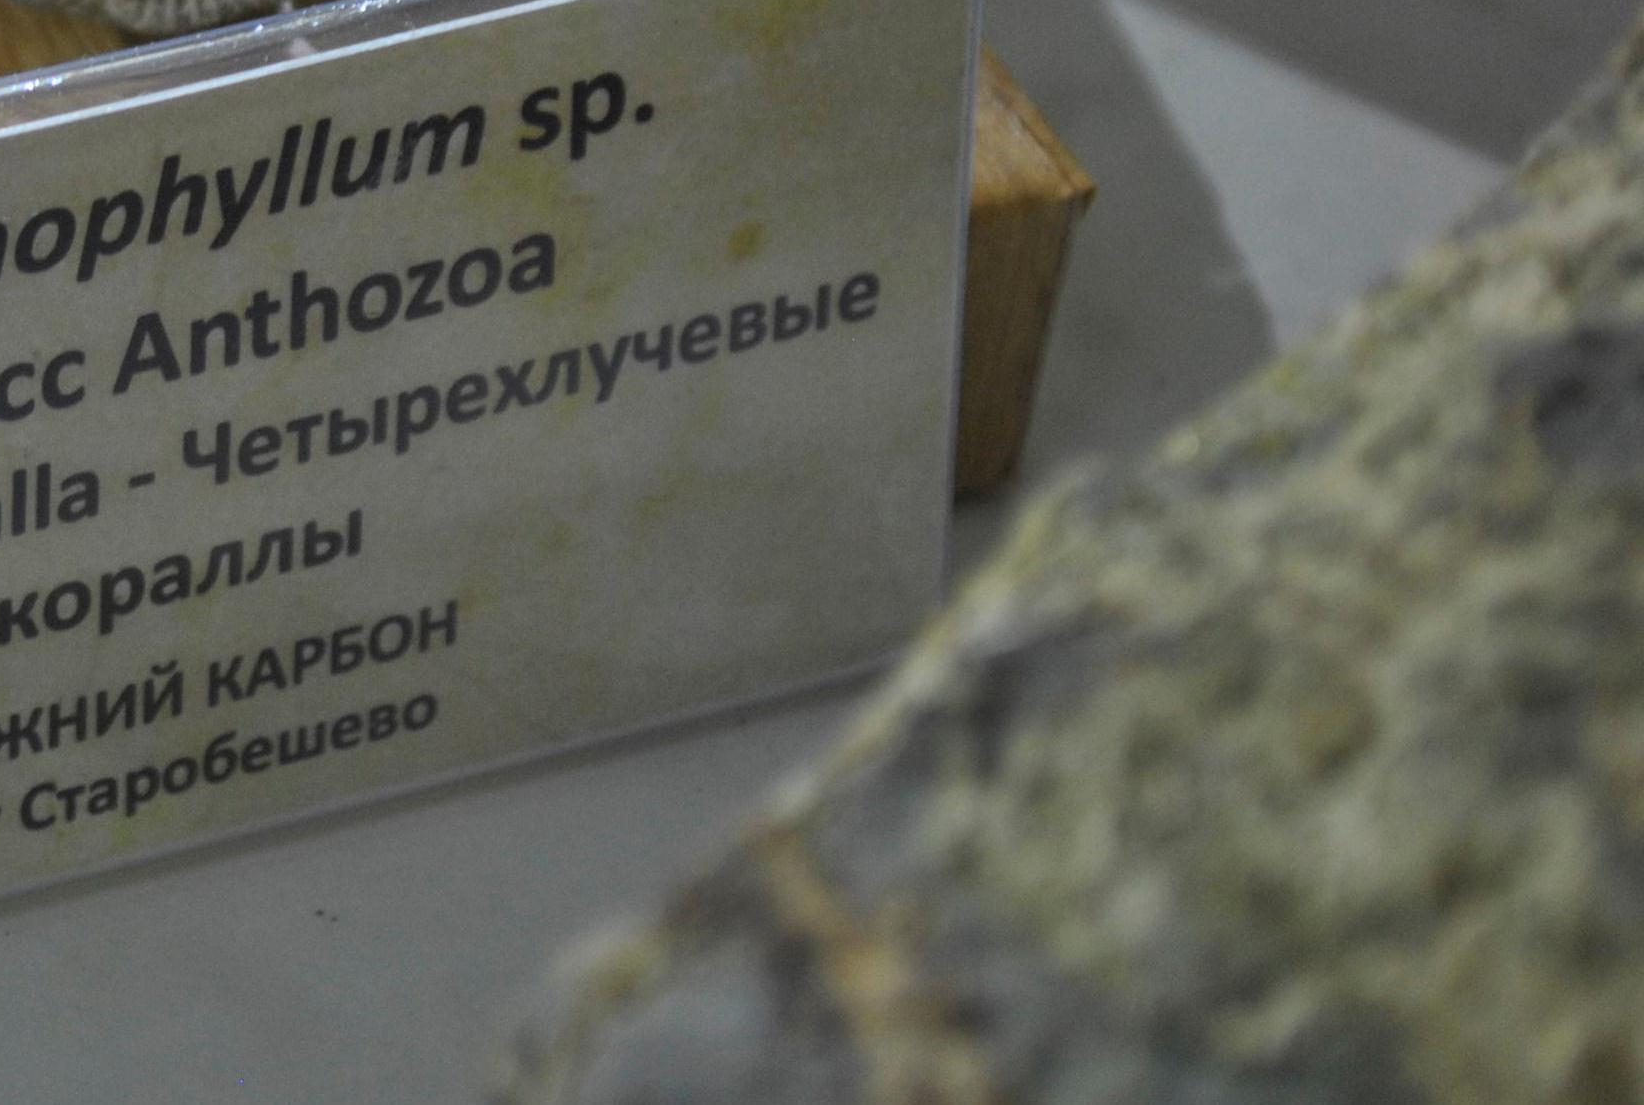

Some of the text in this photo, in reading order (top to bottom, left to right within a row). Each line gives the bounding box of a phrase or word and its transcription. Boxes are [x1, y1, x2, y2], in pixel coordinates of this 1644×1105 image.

[518, 70, 657, 160] sp.
[112, 232, 557, 396] Anthozoa
[182, 271, 882, 487] Четырехлучевые
[206, 599, 459, 708] КАРБОН
[19, 693, 439, 833] Старобешево
